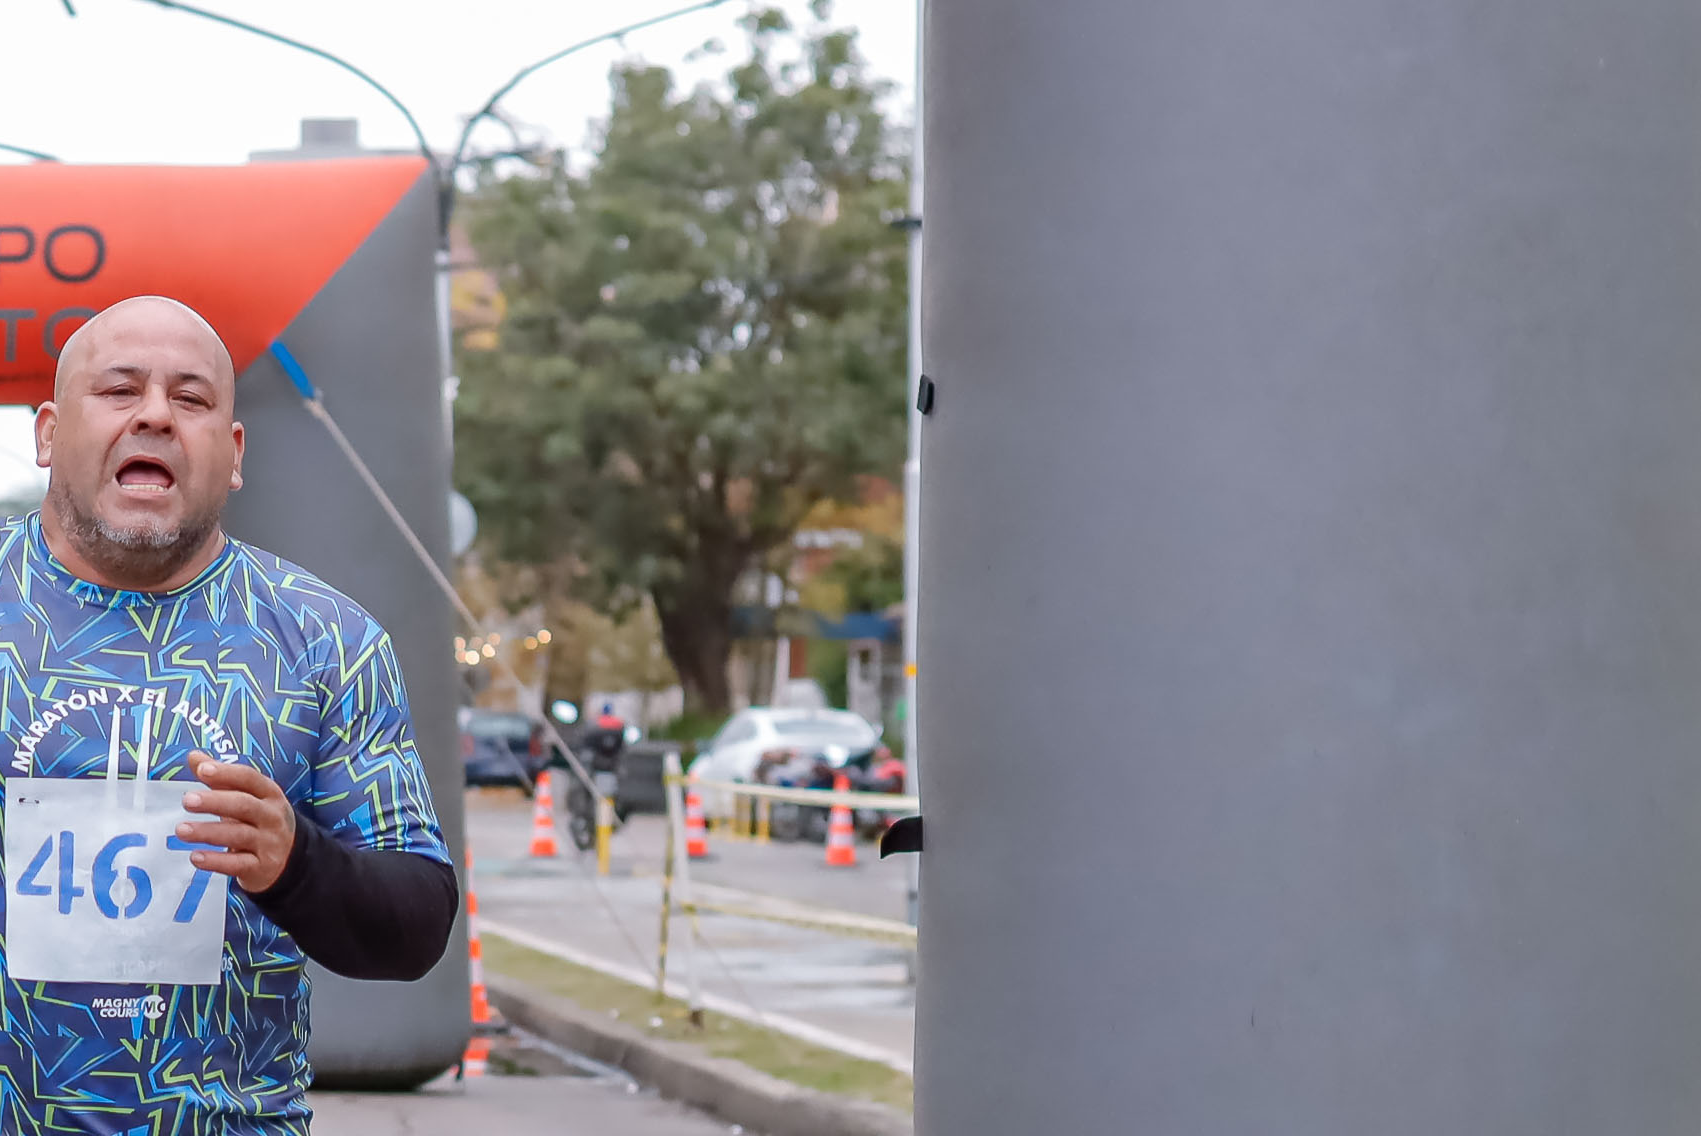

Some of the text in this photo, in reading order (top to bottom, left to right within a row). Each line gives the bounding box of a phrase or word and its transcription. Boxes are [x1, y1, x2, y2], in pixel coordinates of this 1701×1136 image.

[11, 686, 240, 773] MARATÓN X EL AUTISM
[15, 829, 229, 924] 467
[91, 998, 141, 1009] MAGNY
[99, 1007, 140, 1018] COURS
